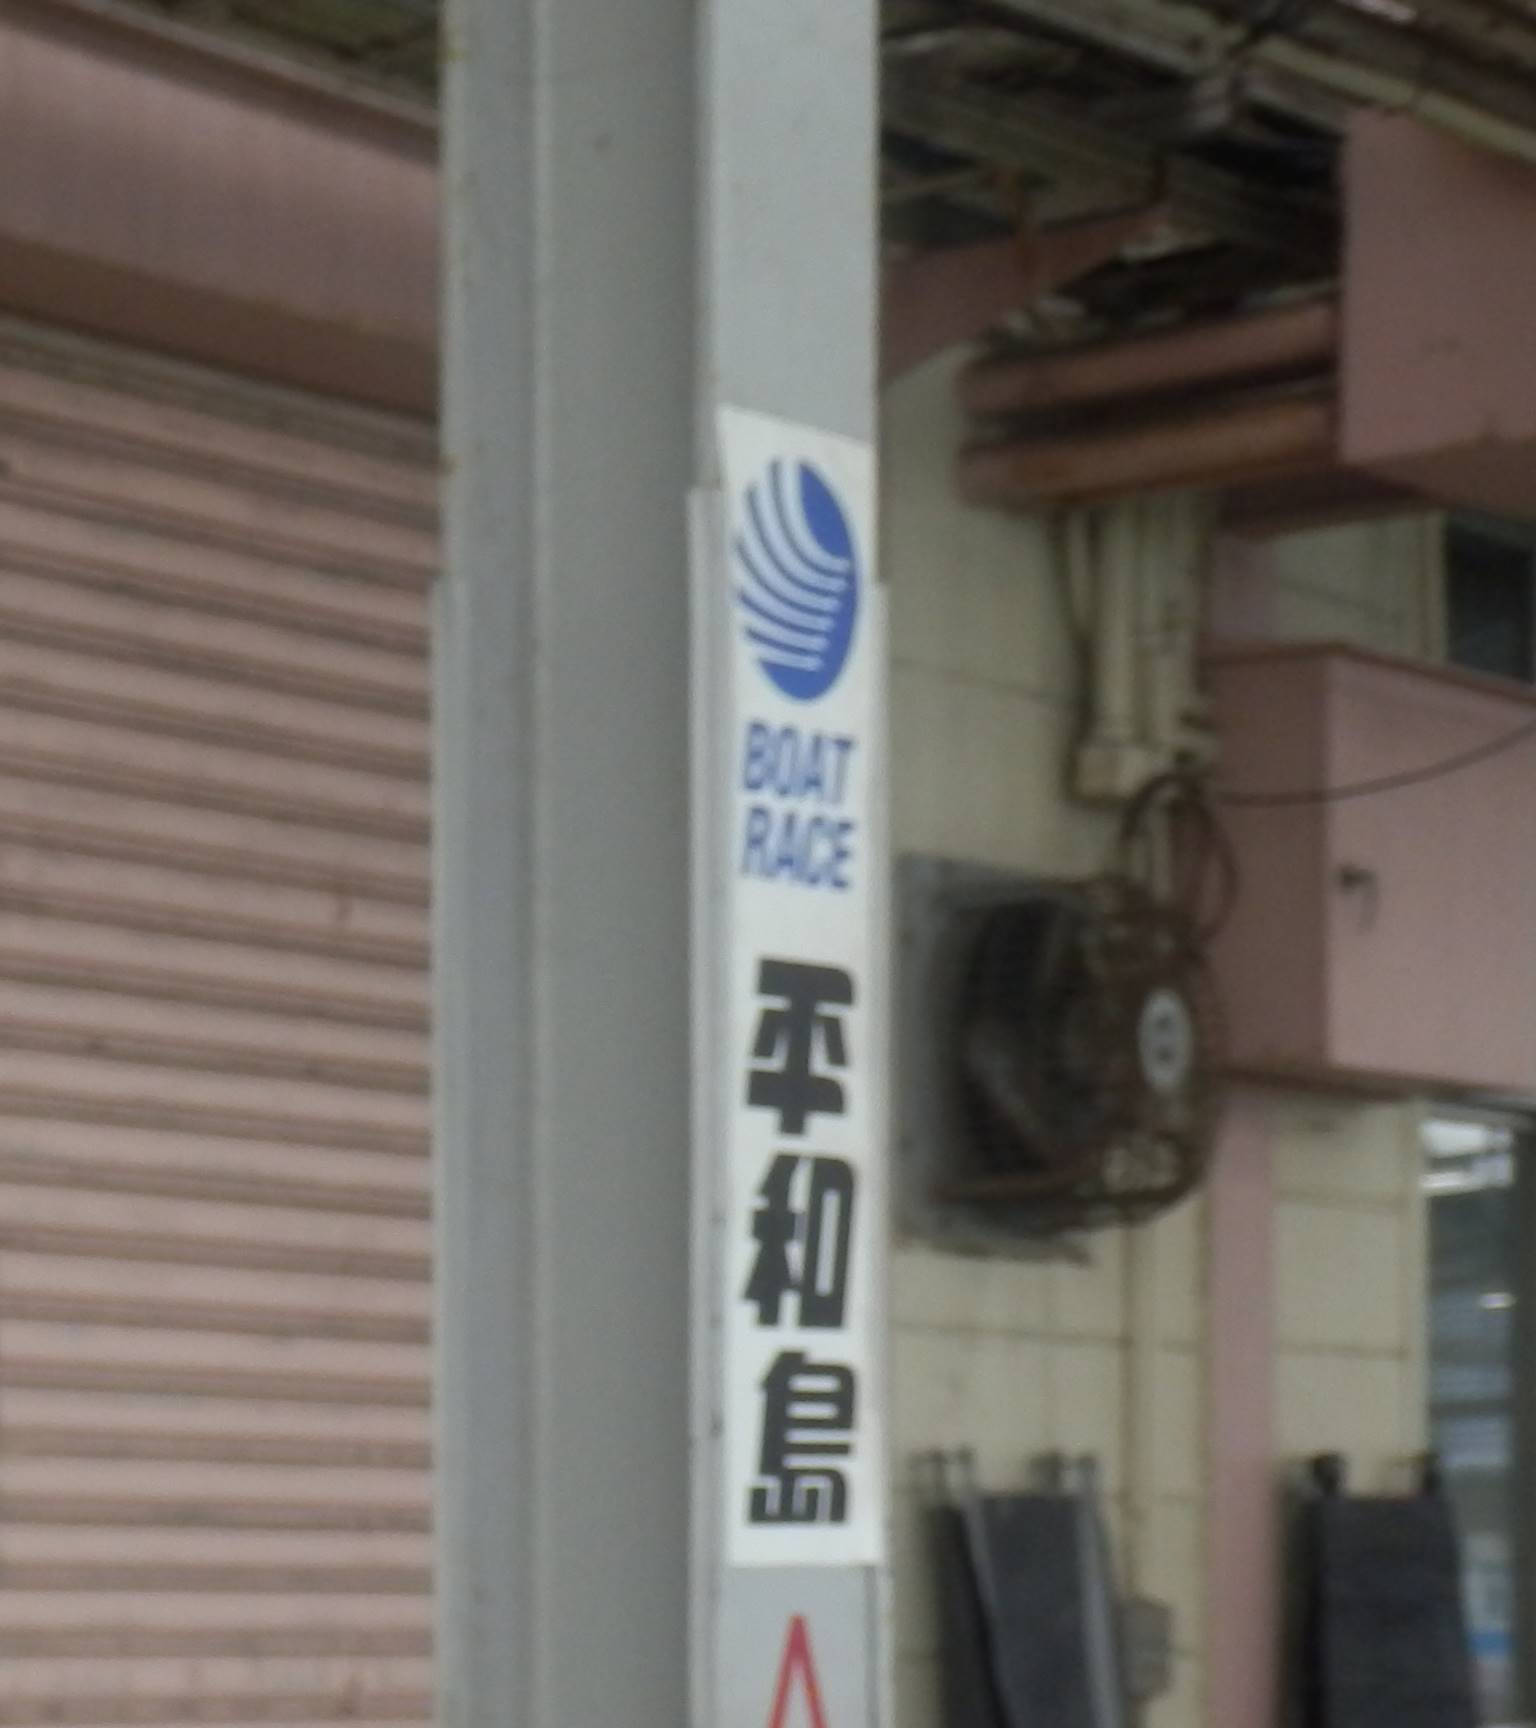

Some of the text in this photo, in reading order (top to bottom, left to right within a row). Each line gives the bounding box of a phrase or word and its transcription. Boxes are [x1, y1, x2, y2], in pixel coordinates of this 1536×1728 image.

[744, 719, 856, 804] BOAT
[741, 805, 854, 890] RACE
[743, 956, 858, 1524] 平和島
